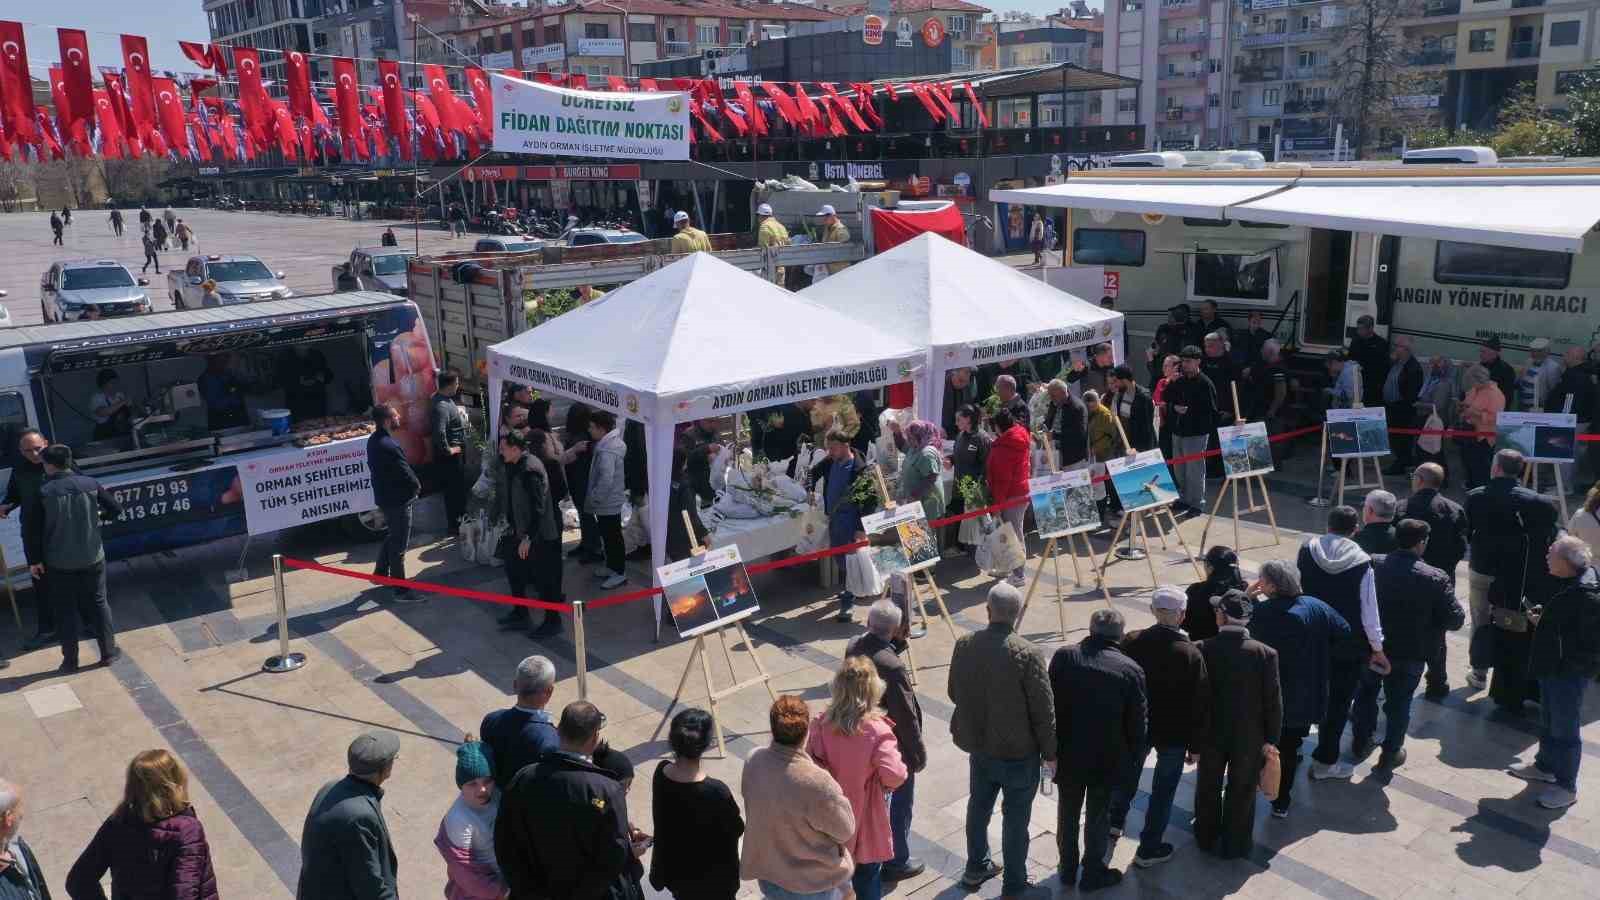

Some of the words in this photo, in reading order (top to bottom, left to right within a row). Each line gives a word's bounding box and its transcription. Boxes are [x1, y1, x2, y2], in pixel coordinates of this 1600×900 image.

[501, 109, 550, 132] FİDAN
[556, 115, 620, 137] DAĞITIM
[624, 121, 684, 141] NOKTASI
[522, 140, 548, 149] AYDIN
[550, 141, 580, 151] ORMAN
[824, 163, 845, 179] USTA
[1393, 287, 1442, 305] ANGIN
[1448, 288, 1524, 310] YÖNETİM
[1530, 294, 1587, 314] ARACI
[972, 348, 995, 360] AYDIN
[996, 341, 1023, 356] ORMAN
[712, 391, 744, 410] AYDIN
[746, 384, 783, 402] ORMAN
[786, 376, 828, 396] İŞLETME
[829, 367, 888, 389] MÜDÜRLÜĞÜ
[255, 475, 302, 493] ORMAN
[304, 461, 365, 484] ŞEHİTLERİ
[113, 487, 141, 504] 677
[146, 483, 166, 499] 79
[169, 479, 189, 495] 93
[260, 496, 287, 511] TÜM
[289, 478, 371, 506] ŞEHİTLERİMİZ
[118, 505, 146, 521] 413
[150, 501, 167, 516] 47
[172, 498, 191, 512] 46
[301, 500, 350, 520] ANISINA
